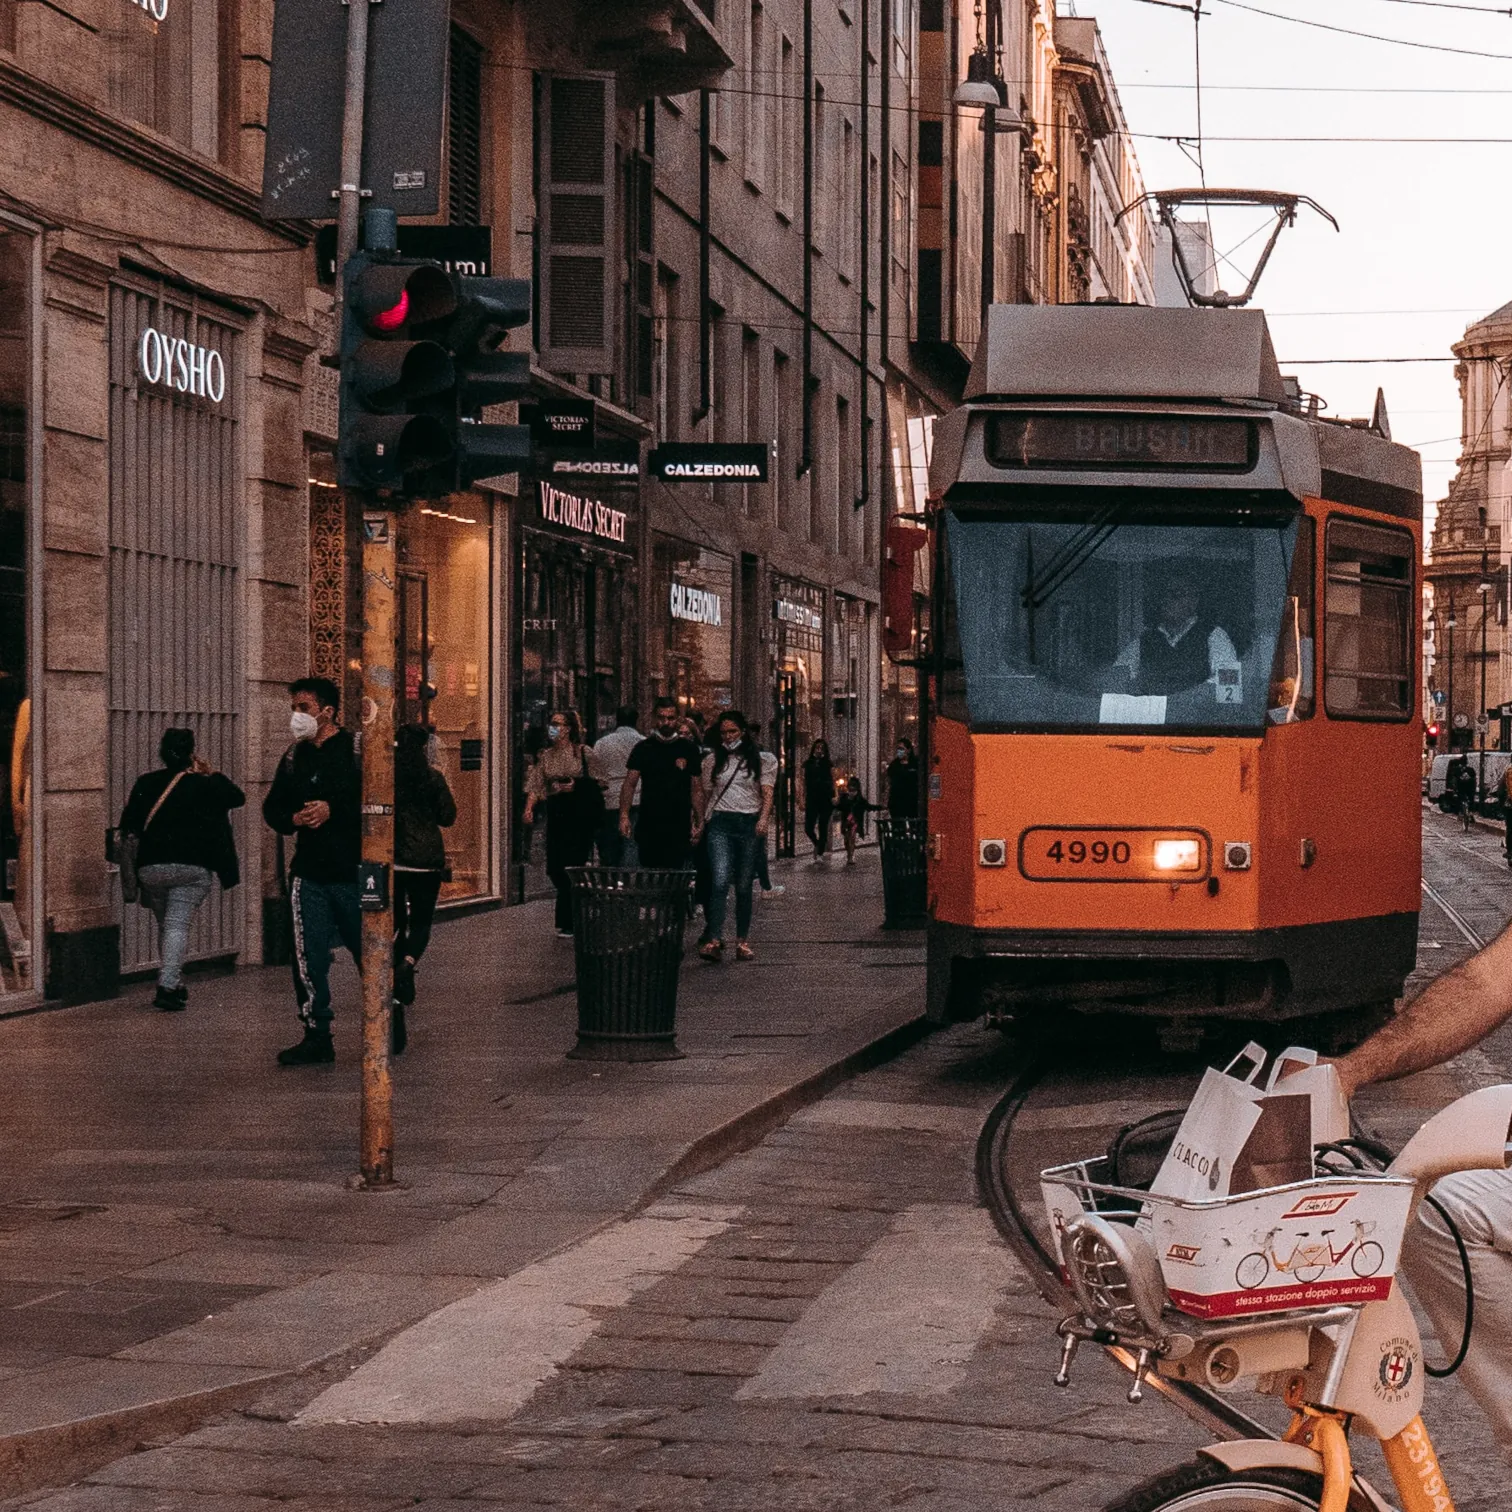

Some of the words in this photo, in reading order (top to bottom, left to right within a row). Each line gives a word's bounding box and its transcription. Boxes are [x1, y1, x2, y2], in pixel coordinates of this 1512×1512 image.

[142, 328, 225, 403] OYSHO
[552, 423, 582, 431] SECRET
[664, 464, 760, 476] CALZEDONIA
[595, 500, 627, 542] SECRET
[670, 583, 721, 627] CALZEDONIA
[1225, 687, 1233, 701] 2
[1046, 840, 1131, 864] 4990
[1173, 1142, 1209, 1177] CIACCO
[1235, 1296, 1263, 1306] stessa
[1265, 1291, 1302, 1304] stazione
[1305, 1287, 1338, 1300] doppio
[1340, 1283, 1376, 1295] servizio
[1380, 1337, 1414, 1353] Comune
[1372, 1382, 1410, 1402] Milano
